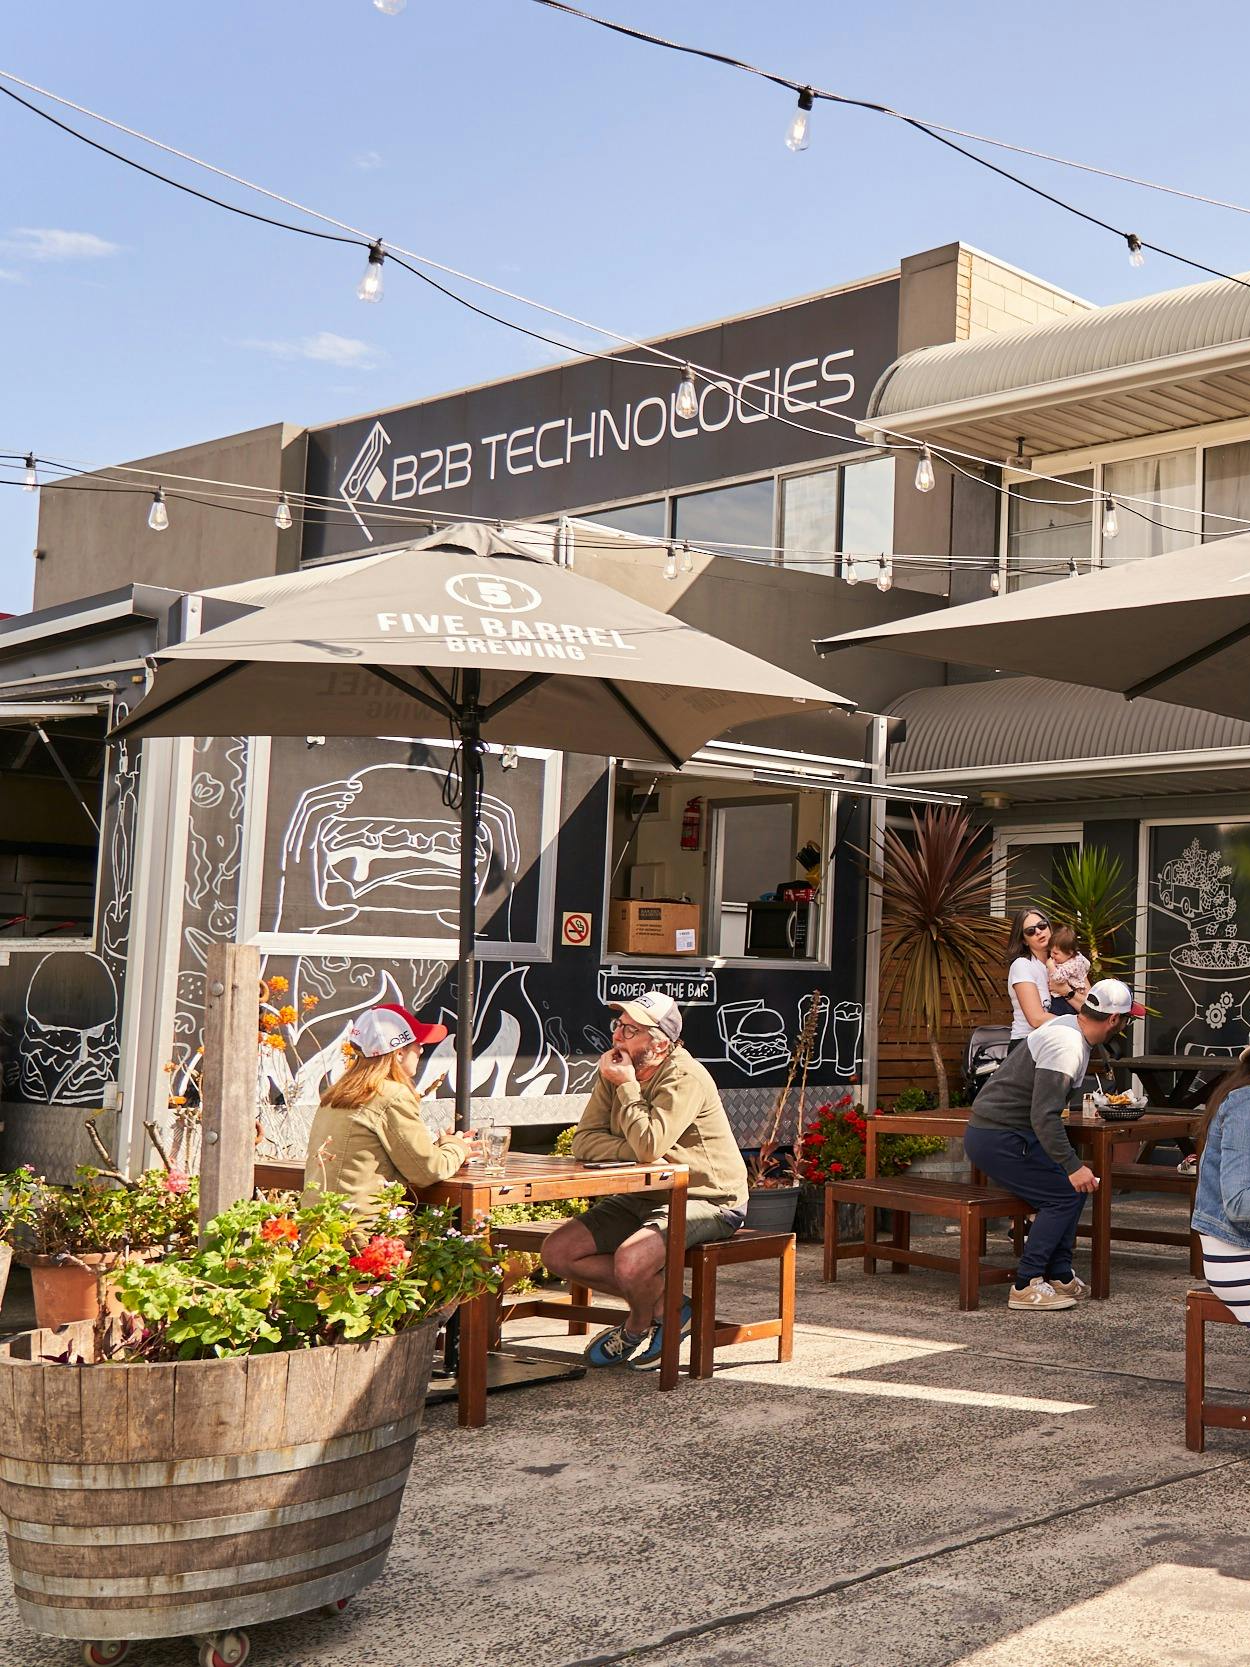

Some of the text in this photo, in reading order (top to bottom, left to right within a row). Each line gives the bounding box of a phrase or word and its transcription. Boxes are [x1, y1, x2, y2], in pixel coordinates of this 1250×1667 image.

[391, 348, 855, 501] B2B TECHNOLOGIES
[479, 582, 512, 606] 5
[376, 612, 637, 650] FIVE BARREL
[447, 636, 586, 661] BREWING
[610, 982, 709, 998] ORDER AT THE BAR
[389, 1030, 411, 1048] QBE
